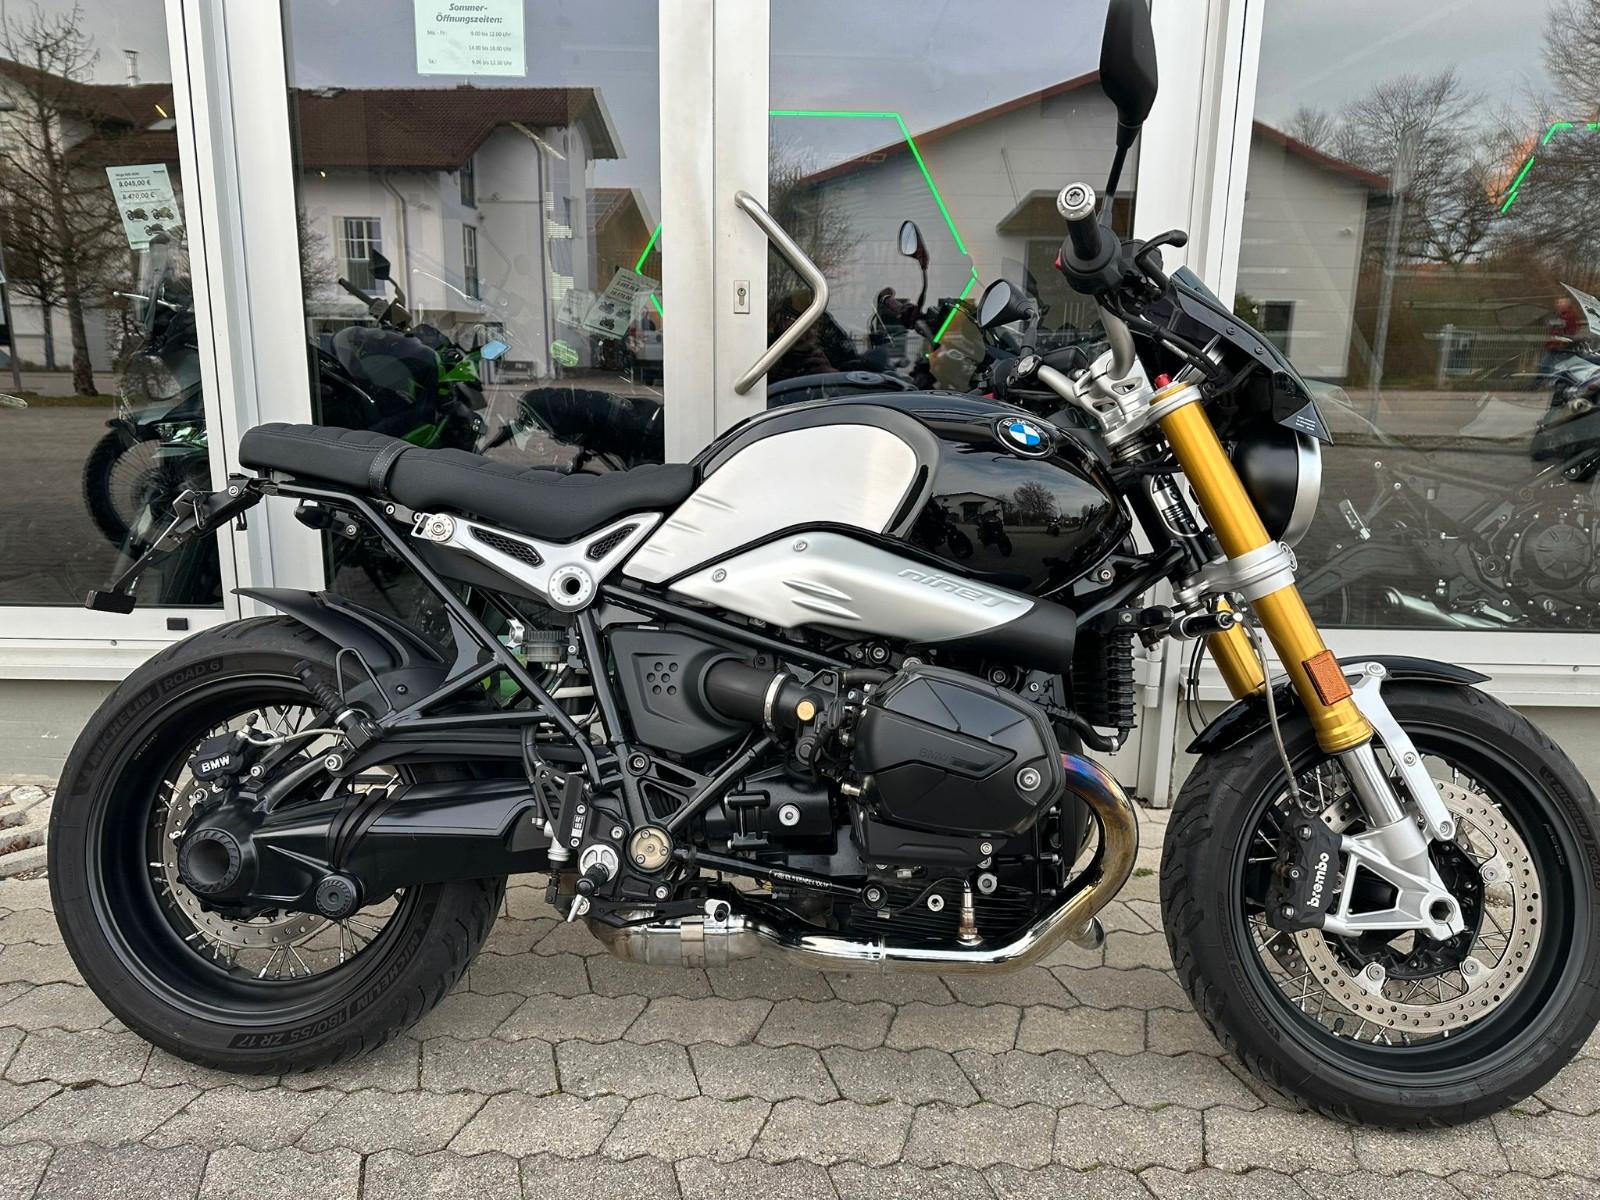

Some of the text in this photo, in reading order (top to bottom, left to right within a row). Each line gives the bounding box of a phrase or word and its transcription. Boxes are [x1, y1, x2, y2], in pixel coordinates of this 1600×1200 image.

[436, 12, 503, 24] Öffnungszeiten:
[449, 3, 488, 12] Sommer-
[87, 693, 154, 768] MICHELIN
[164, 664, 206, 691] ROAD
[209, 660, 220, 672] 6
[201, 755, 230, 773] BMW
[1306, 852, 1330, 908] brembo
[236, 935, 423, 1048] MICHELIN 180/55 ZR 17
